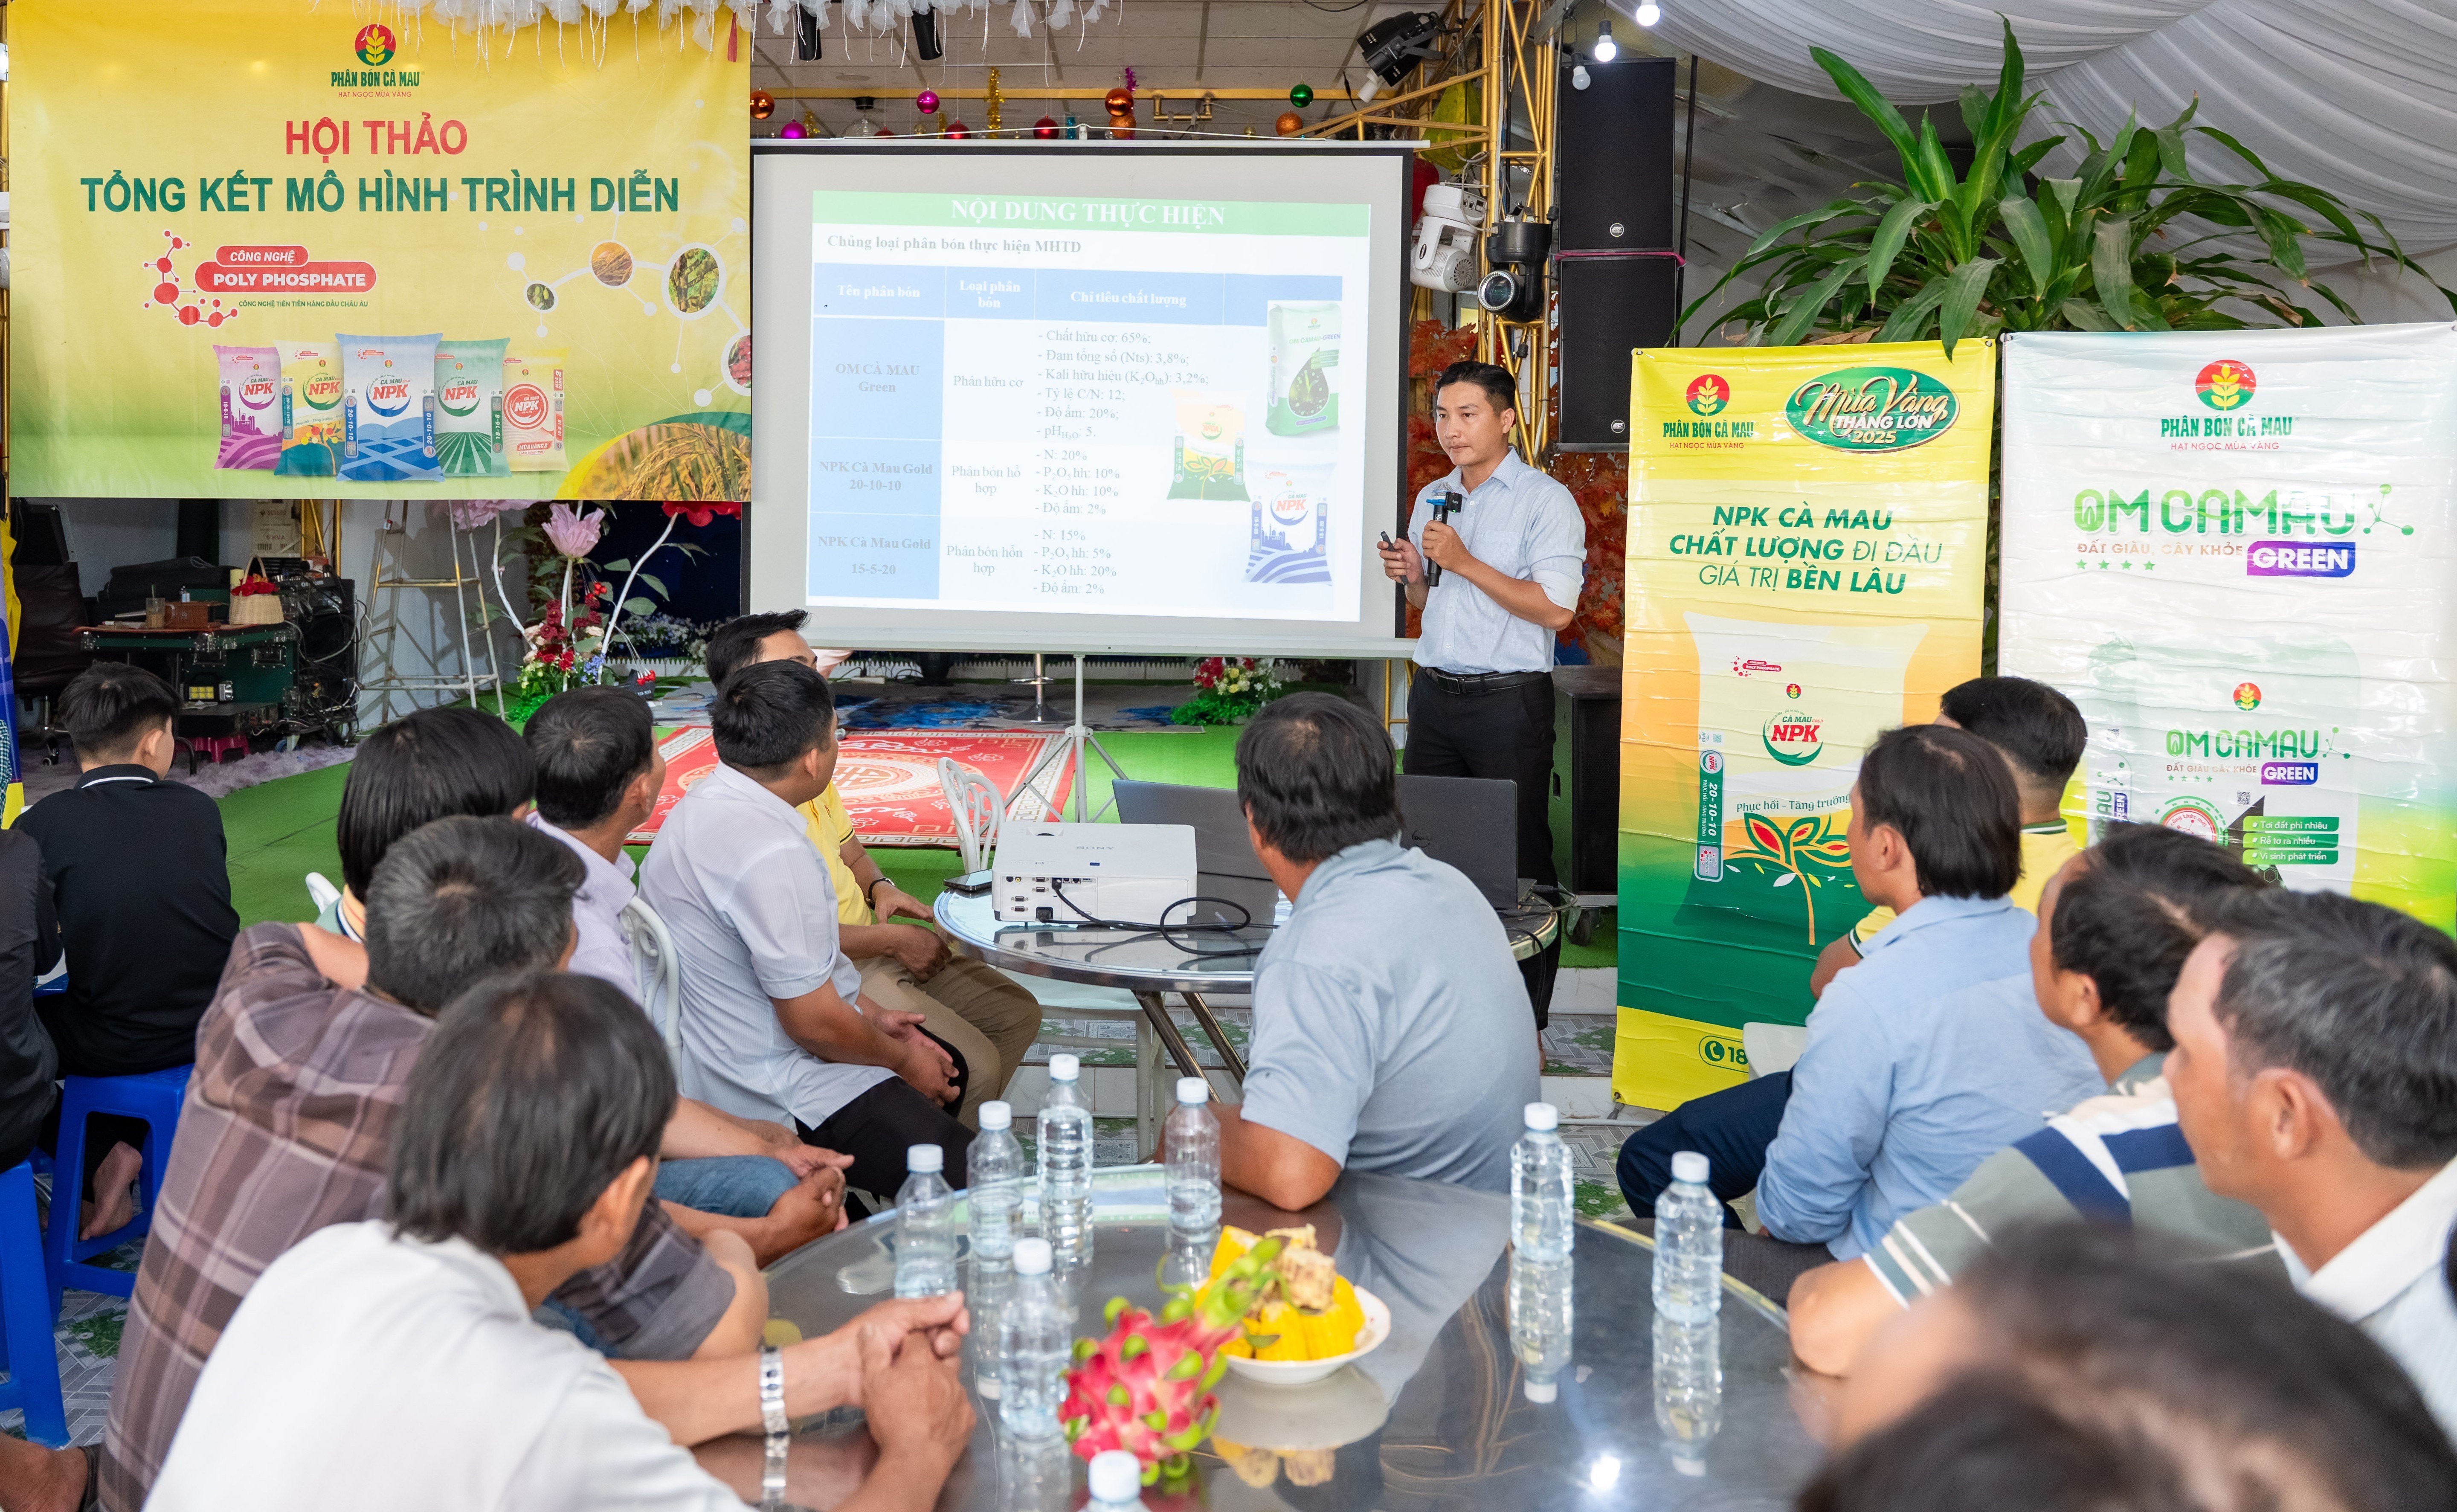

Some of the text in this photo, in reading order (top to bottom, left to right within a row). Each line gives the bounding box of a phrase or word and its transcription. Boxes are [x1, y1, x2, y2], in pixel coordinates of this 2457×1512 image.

[331, 69, 420, 87] PHÂN BÓN CÀ MAU
[286, 112, 468, 163] HỘI THẢO
[81, 169, 679, 213] TỔNG KẾT MÔ HÌNH TRÌNH DIỄN
[951, 197, 1225, 230] NỘI DUNG THỰC HIỆN
[827, 234, 1081, 254] Chủng loại phân bón thực hiện MHTD
[230, 250, 295, 264] CÔNG NGHỆ
[214, 273, 366, 286] POLY PHOSPHATE
[959, 280, 1021, 295] Loại phân
[837, 284, 920, 300] Tên phân bón
[1070, 289, 1187, 308] Chỉ tiêu chất lượng
[258, 299, 275, 308] NGHỆ
[292, 299, 305, 307] TIẾN
[326, 299, 339, 307] ĐẦU
[978, 296, 1001, 308] bón
[1046, 328, 1152, 345] Chất hữu cơ: 65%;
[1046, 347, 1189, 366] Đạm tổng số (Nts): 3,8%;
[835, 360, 920, 376] OM CÀ MAU
[244, 382, 274, 396] NPK
[308, 381, 340, 395] NPK
[858, 380, 896, 393] Green
[953, 375, 1024, 388] Phân hữu cơ
[372, 384, 409, 400] NPK
[444, 385, 478, 401] NPK
[514, 400, 539, 412] NPK
[1795, 374, 1949, 437] Mùa Vàng
[1663, 419, 1754, 438] PHÂN BÓN CÀ MAU
[1835, 412, 1934, 430] THẮNG LỚN
[2161, 414, 2293, 438] PHÂN BÓN CÀ MAU
[1851, 430, 1897, 444] 2025
[1669, 442, 1682, 450] HẠT
[1683, 442, 1706, 450] NGỌC
[2171, 441, 2280, 453] HẠT NGỌC MÙA VÀNG
[819, 461, 933, 475] NPK Cà Mau Gold
[849, 479, 902, 491] 20-10-10
[1275, 499, 1306, 511] NPK
[2074, 488, 2150, 533] OM
[1712, 501, 1893, 531] NPK CÀ MAU
[1669, 528, 1943, 564] CHẤT LƯỢNG ĐI ĐẦU
[2077, 538, 2243, 557] ĐẤT GIÀU, CÂY KHỎE
[2251, 546, 2349, 571] GREEN
[1699, 560, 1906, 595] GIÁ TRỊ BỀN LÂU
[1771, 725, 1820, 742] NPK
[2166, 729, 2319, 758] OM CAMAU
[2166, 762, 2184, 772] ĐẤT
[2212, 764, 2231, 773] CÂY
[2234, 763, 2257, 773] KHỎE
[2264, 766, 2315, 781] GREEN
[1708, 782, 1718, 836] 20-10-10
[1737, 803, 1761, 813] Phục
[1764, 800, 1779, 810] hồi
[1789, 801, 1814, 811] Tăng
[2116, 795, 2125, 819] REEN
[2170, 815, 2182, 826] công
[2261, 821, 2273, 829] Tơi
[2274, 820, 2288, 829] đất
[2290, 821, 2303, 830] phì
[2261, 836, 2271, 845] Rễ
[2288, 853, 2306, 862] phát
[2308, 851, 2327, 860] triển
[1728, 1046, 1748, 1065] 18
